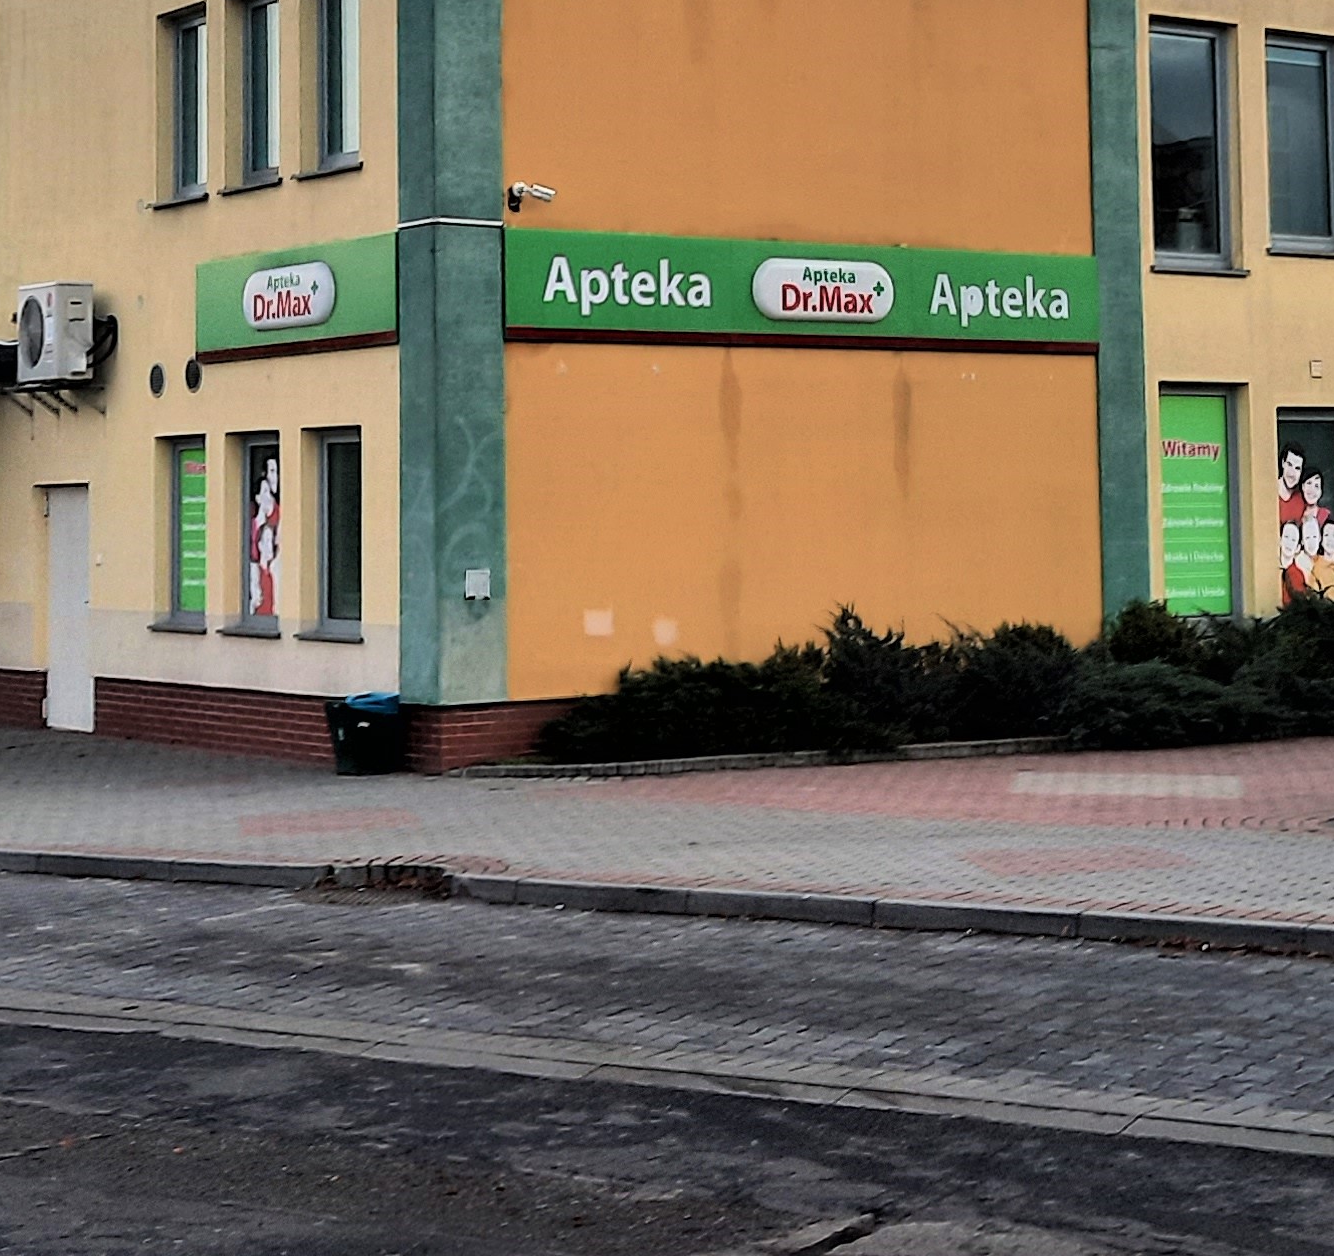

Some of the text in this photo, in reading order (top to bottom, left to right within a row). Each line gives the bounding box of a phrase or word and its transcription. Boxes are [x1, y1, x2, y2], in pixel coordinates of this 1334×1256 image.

[266, 272, 300, 292] Apteka
[542, 255, 712, 315] Apteka
[802, 266, 856, 285] Apteka
[253, 291, 311, 322] Dr.Max
[781, 283, 874, 315] Dr.Max
[929, 273, 1070, 326] Apteka
[1162, 440, 1220, 462] Witamy
